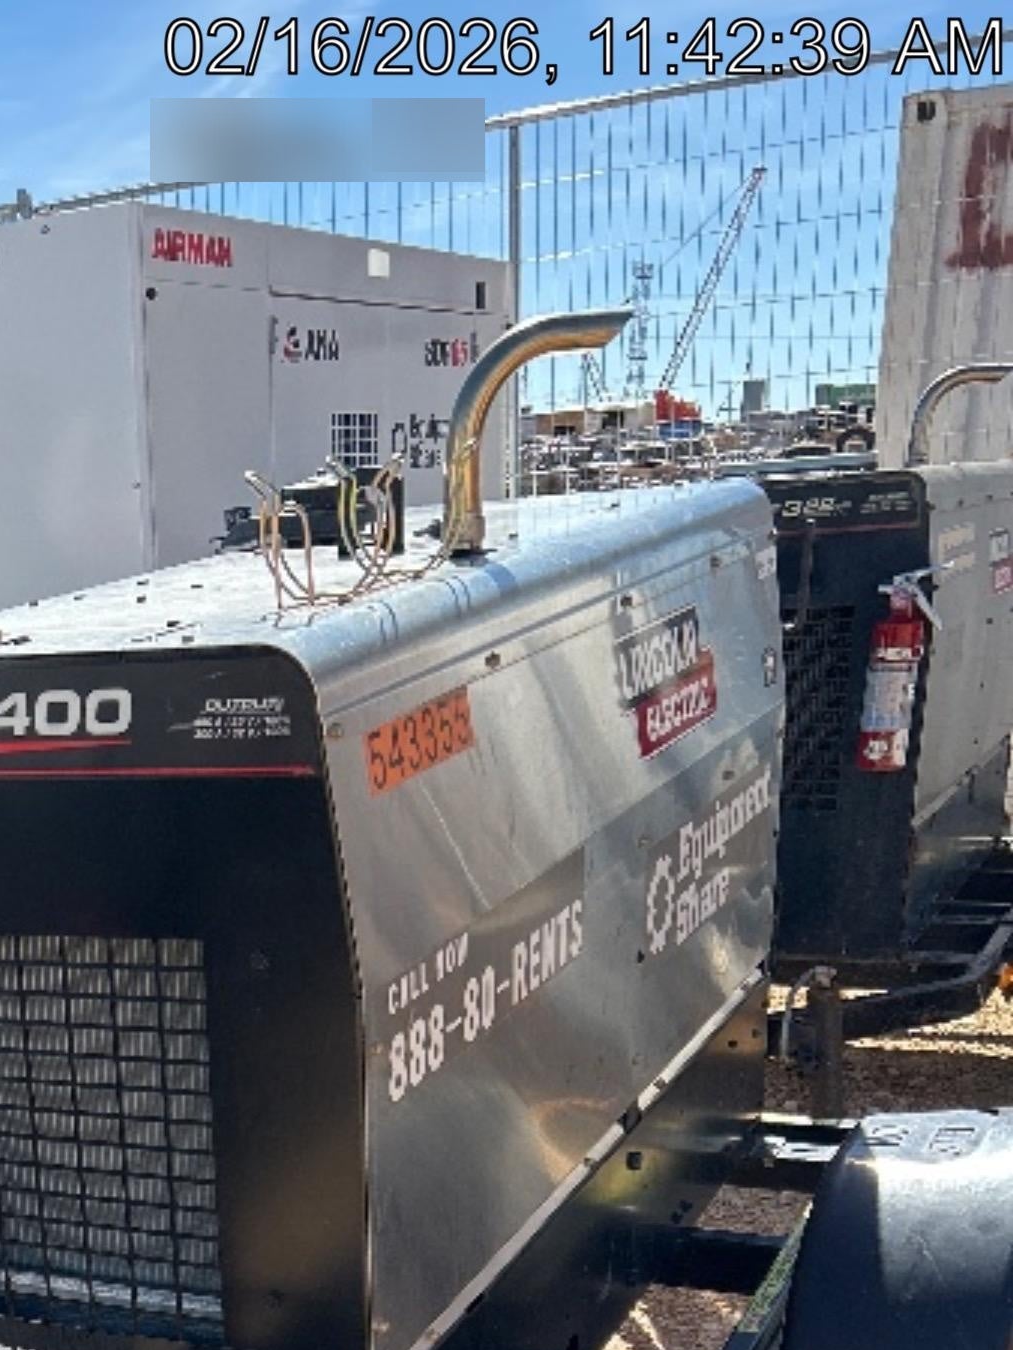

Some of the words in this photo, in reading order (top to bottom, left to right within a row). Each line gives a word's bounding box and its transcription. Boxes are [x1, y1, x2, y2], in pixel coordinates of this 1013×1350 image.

[676, 762, 772, 883] Equipment
[676, 867, 730, 946] Share
[387, 961, 430, 1016] CALL
[435, 931, 469, 983] NOW
[388, 898, 584, 1103] 888-80-RENTS
